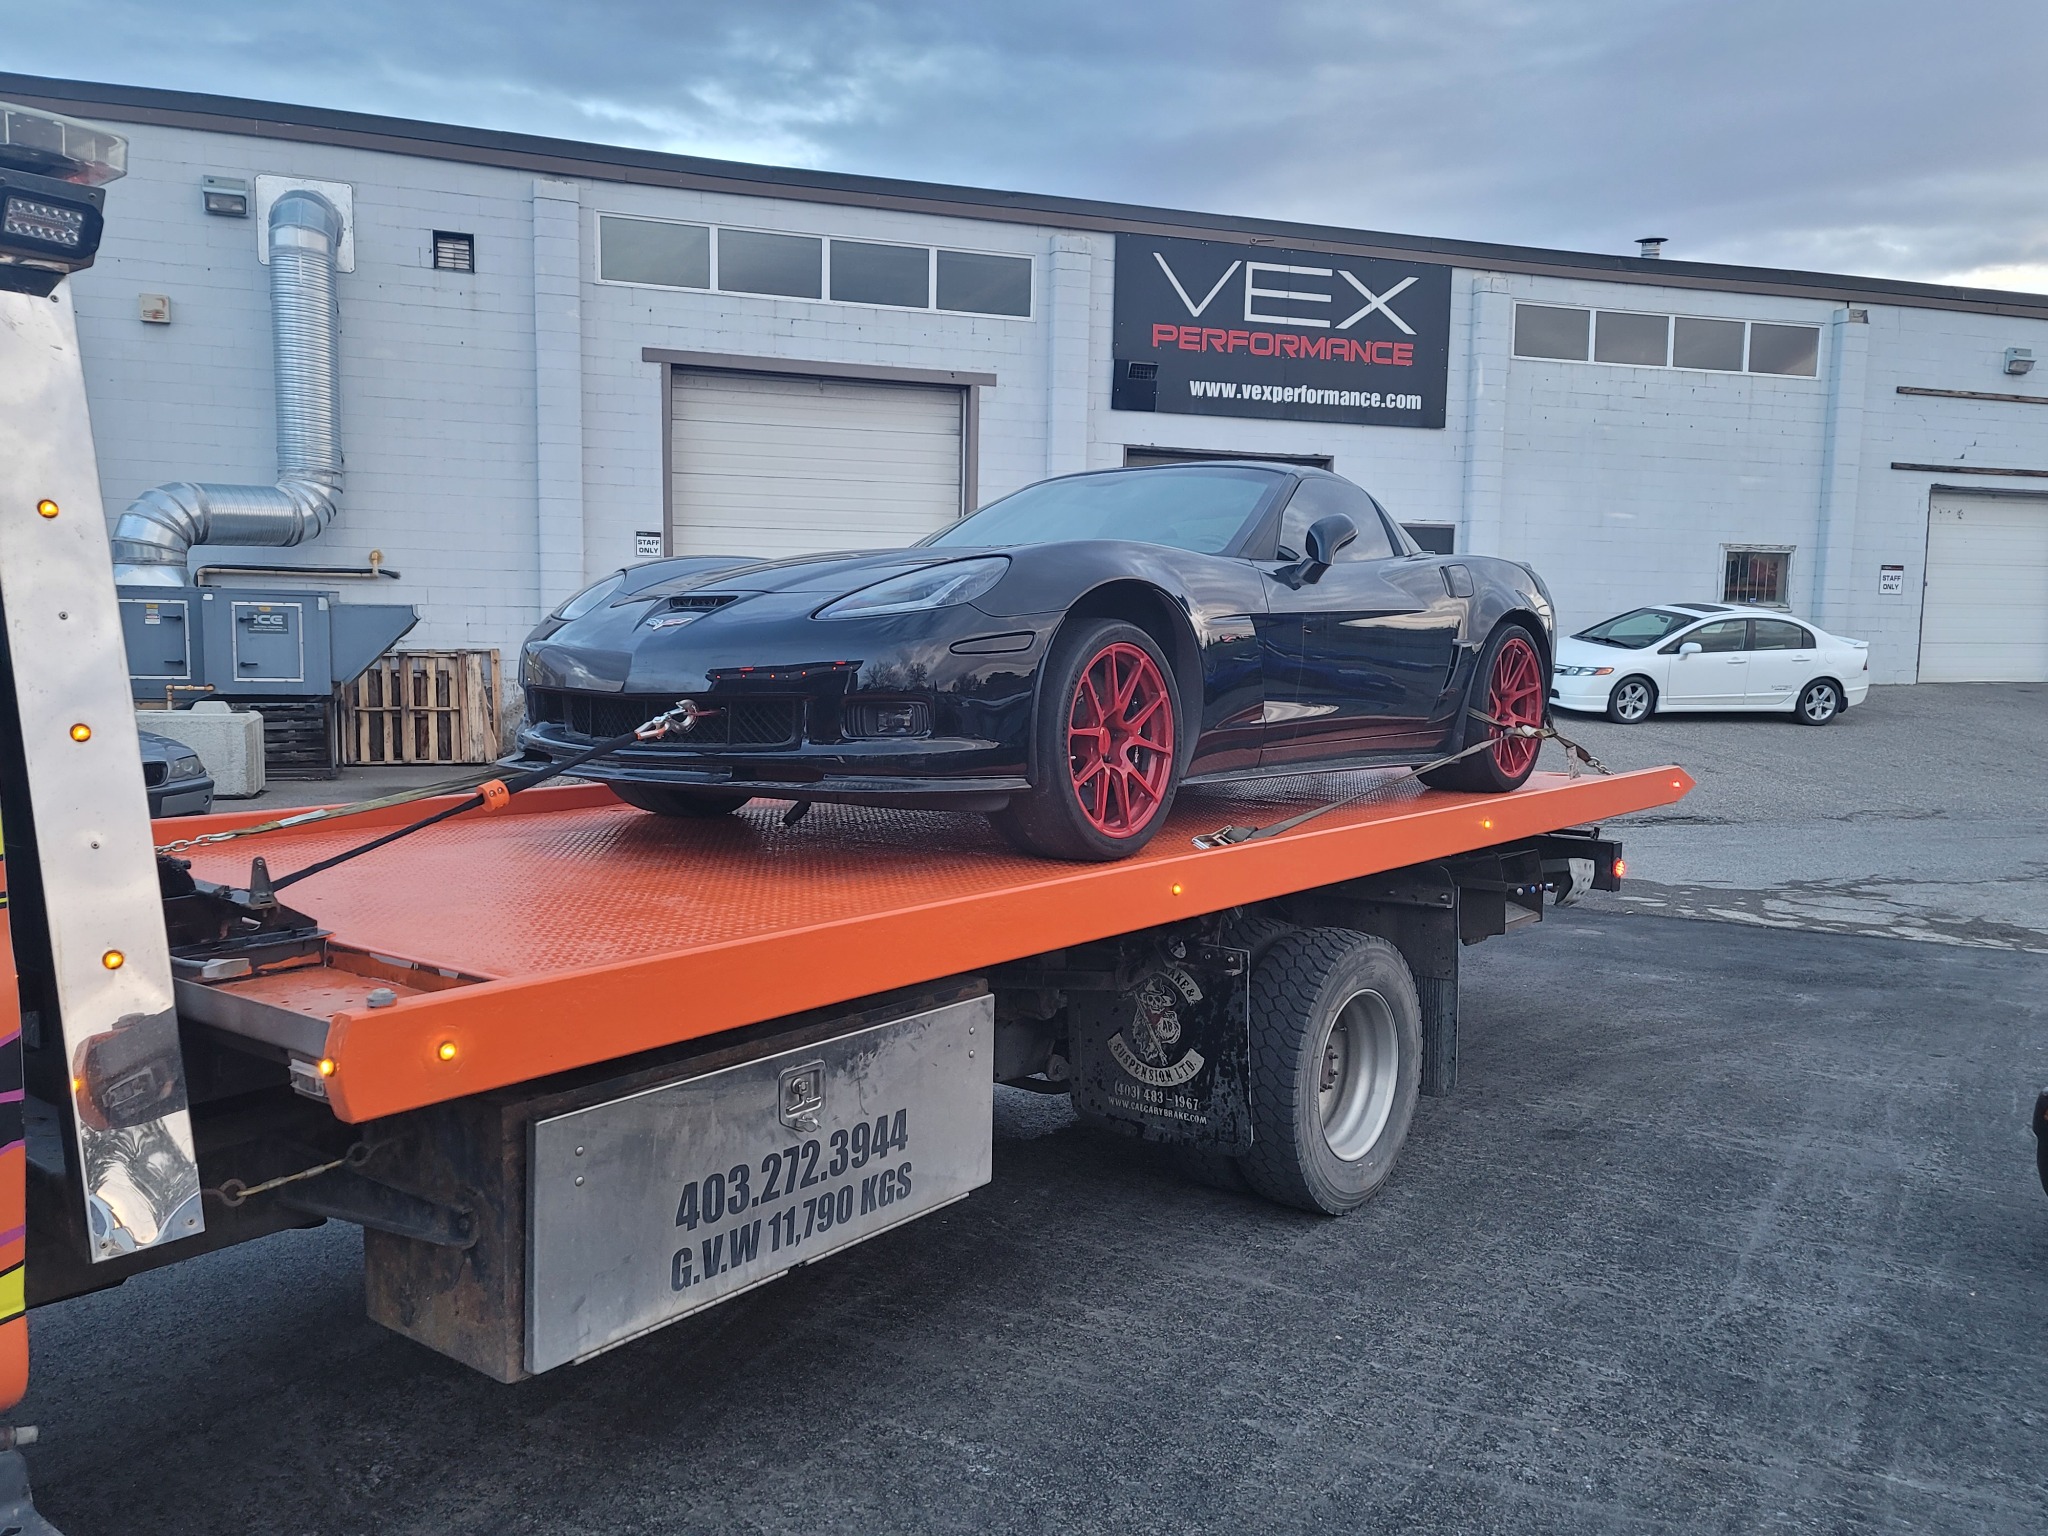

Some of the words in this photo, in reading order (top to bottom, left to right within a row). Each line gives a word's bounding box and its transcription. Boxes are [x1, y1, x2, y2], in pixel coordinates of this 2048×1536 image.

[1152, 252, 1420, 335] VEX
[1152, 323, 1414, 366] PERFORMANCE
[1189, 380, 1422, 410] www.vexperformance.com
[253, 614, 284, 625] ICE
[1113, 1043, 1174, 1083] SUSPENSION
[1108, 1096, 1207, 1125] WWW.CALGARYBRAKE.COM
[1114, 1080, 1140, 1100] (403)
[1143, 1089, 1164, 1104] 483
[675, 1108, 909, 1232] 403.272.3944
[670, 1218, 762, 1292] G.V.W
[767, 1184, 854, 1252] 11,790
[860, 1161, 912, 1216] KGS
